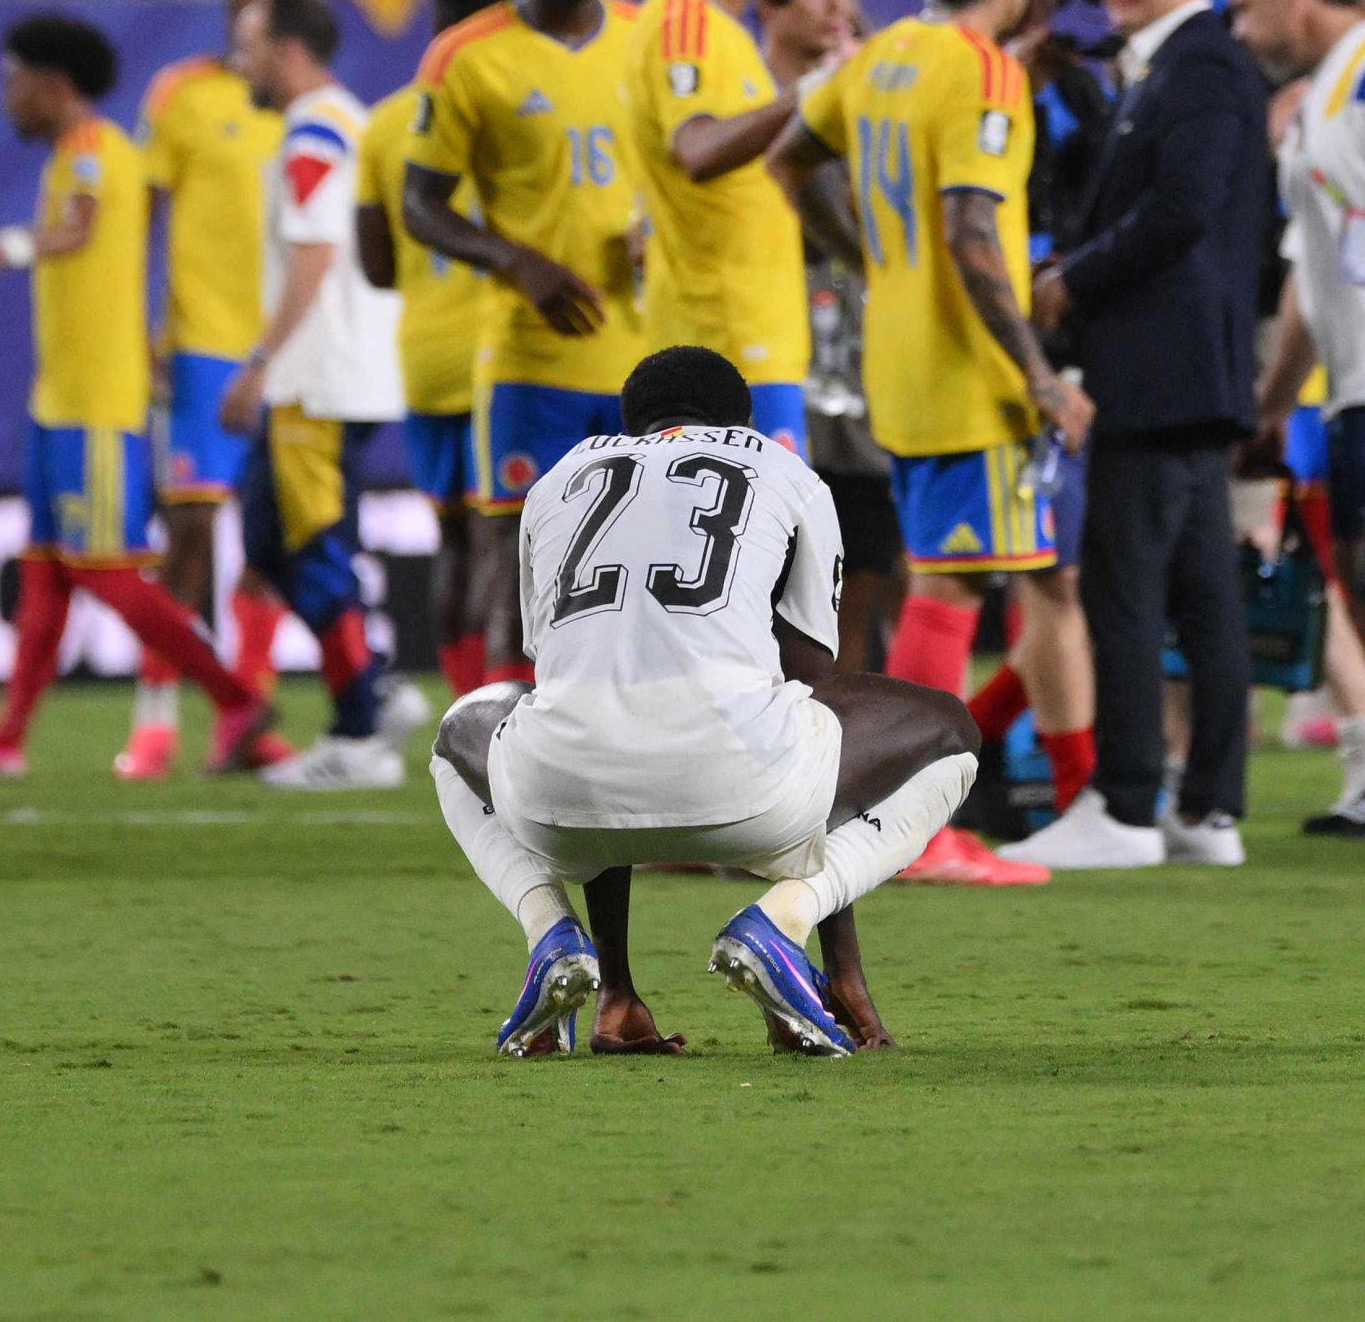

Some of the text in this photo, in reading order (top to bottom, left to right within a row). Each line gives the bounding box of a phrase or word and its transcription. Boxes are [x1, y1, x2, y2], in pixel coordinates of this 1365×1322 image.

[566, 123, 615, 187] 16
[857, 114, 919, 269] 14
[549, 452, 758, 629] 23
